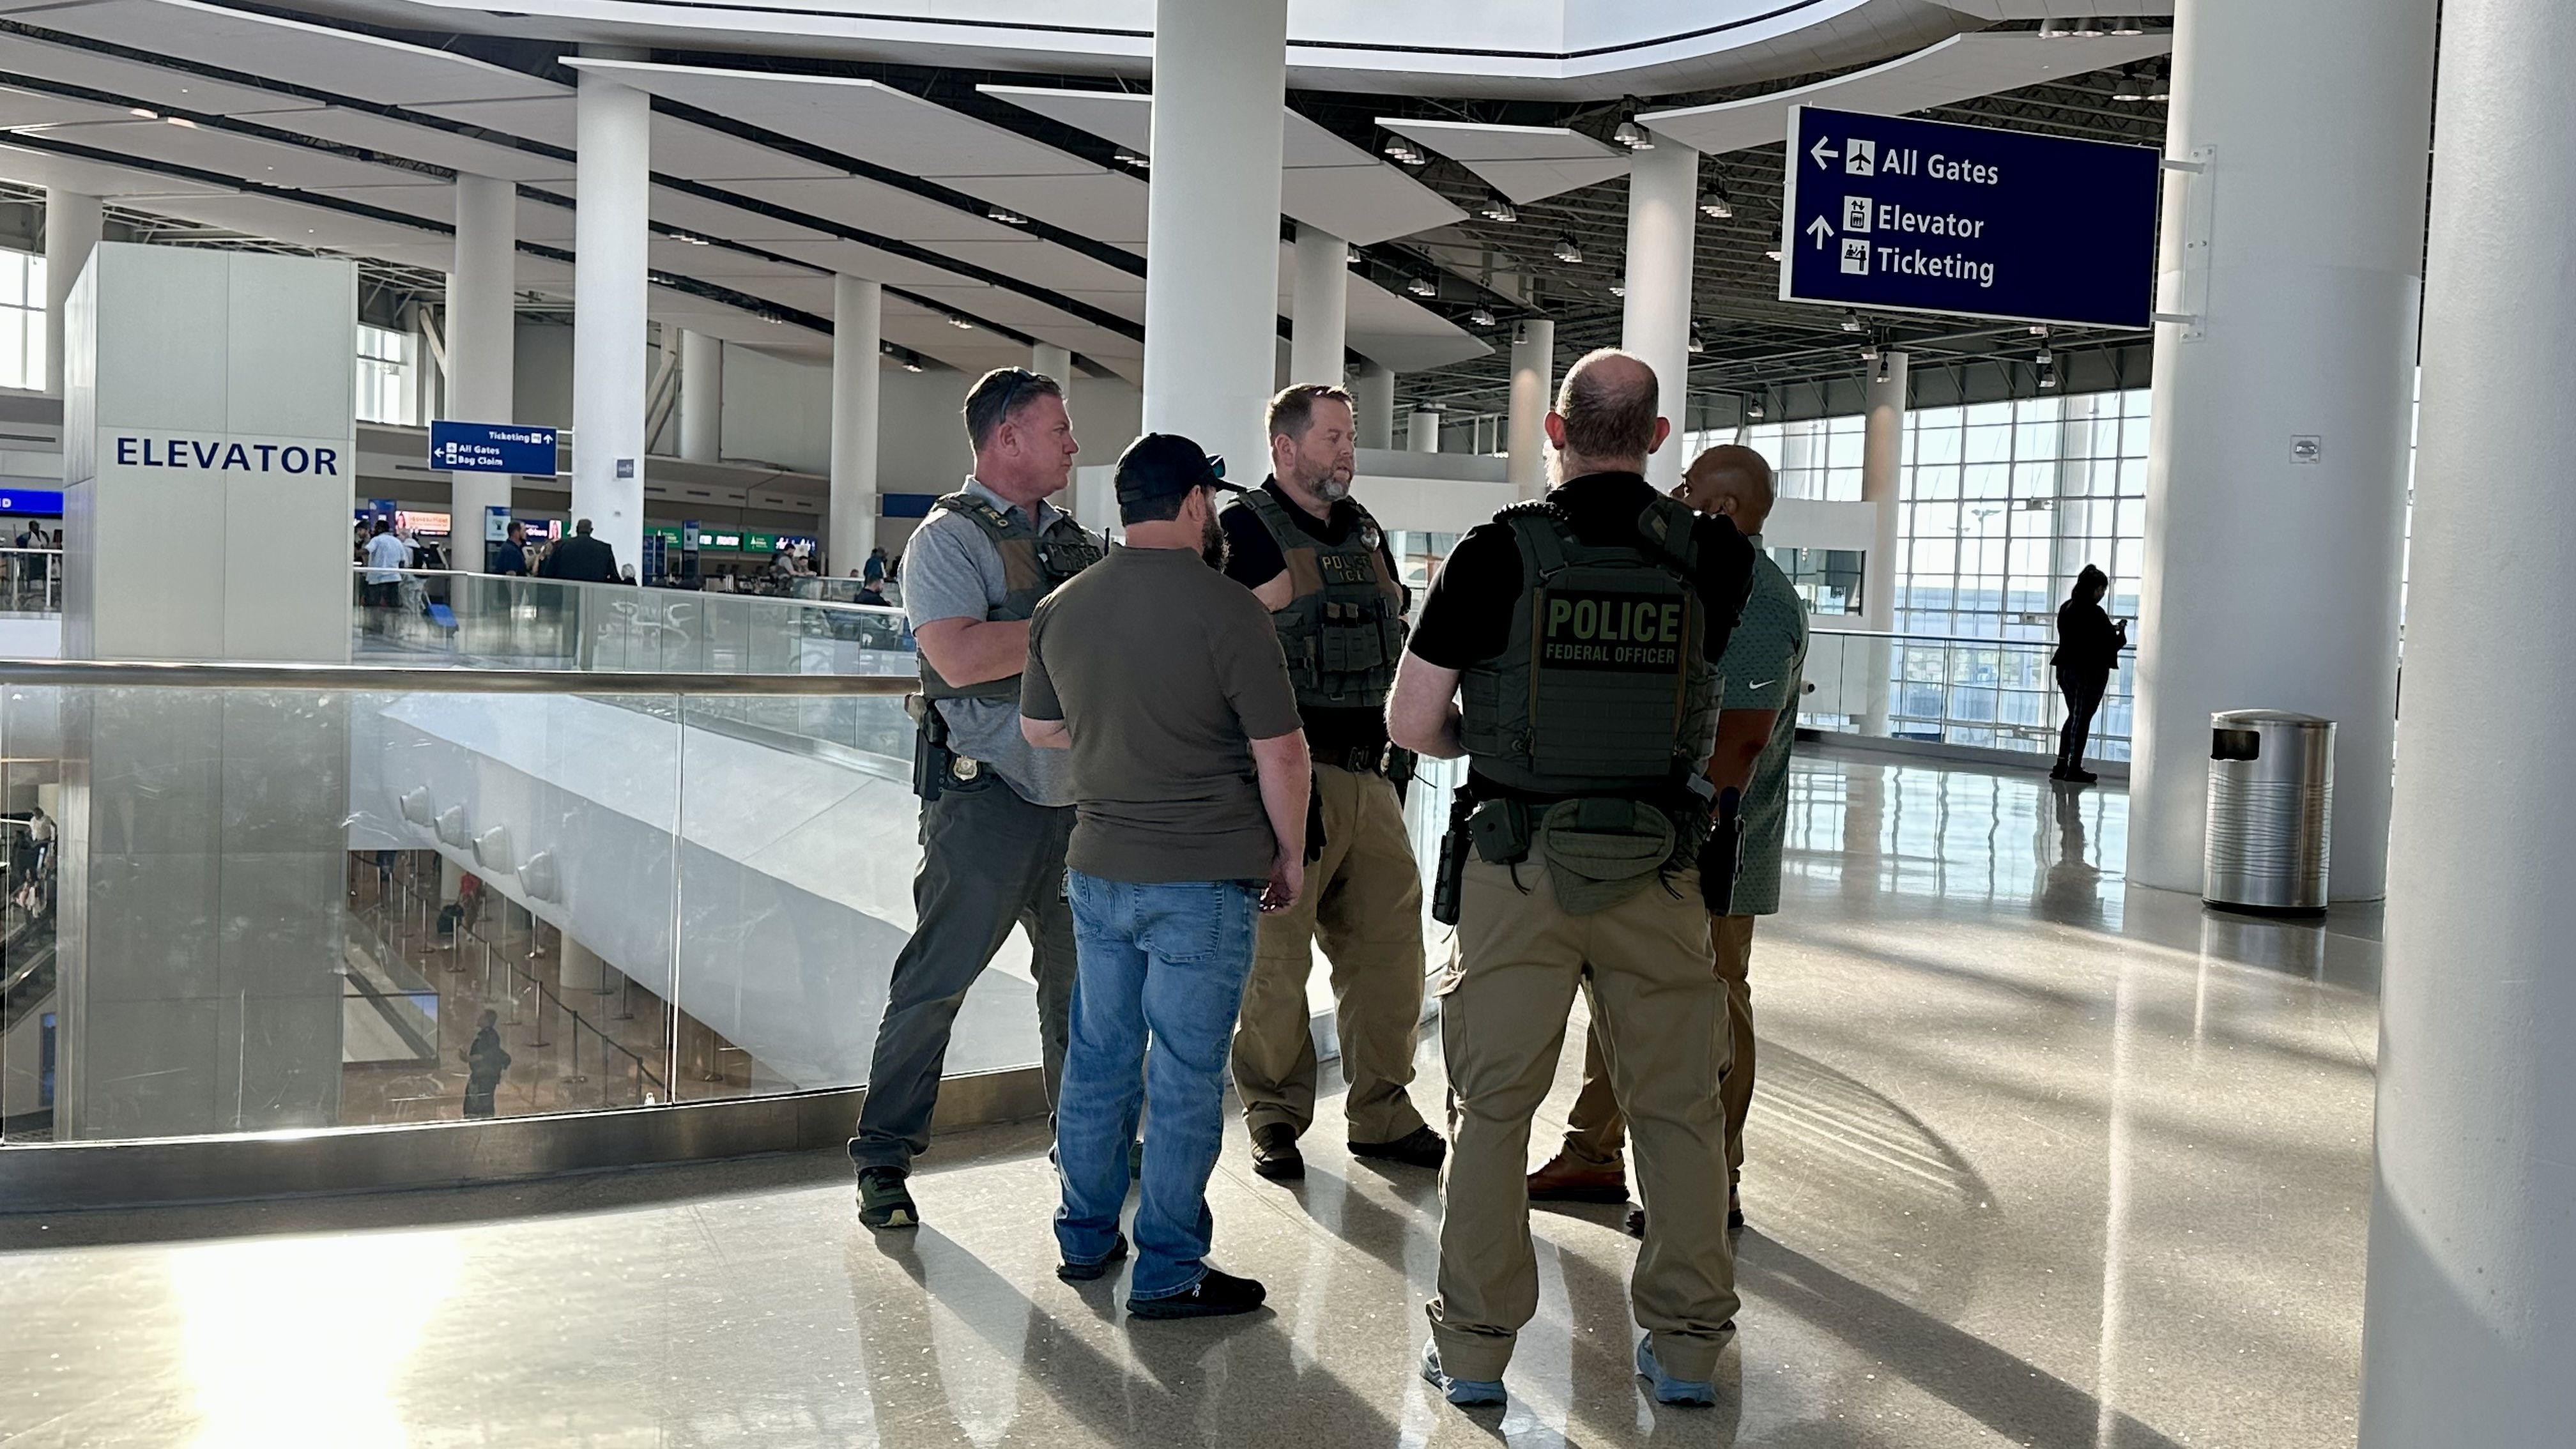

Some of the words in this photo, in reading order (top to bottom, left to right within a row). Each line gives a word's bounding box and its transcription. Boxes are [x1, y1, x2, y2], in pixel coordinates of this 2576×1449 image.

[1882, 149, 1917, 176] All
[1928, 154, 1998, 185] Gates
[1879, 204, 1984, 238] Elevator
[1878, 247, 1994, 287] Ticketing
[459, 445, 471, 453] All
[473, 445, 500, 455] Gates
[489, 431, 530, 443] Ticketing
[118, 437, 337, 475] ELEVATOR
[458, 456, 475, 466] Bag
[477, 457, 503, 466] Claim
[1547, 598, 1680, 642] POLICE
[1545, 643, 1609, 661] FEDERAL
[1614, 646, 1675, 664] OFFICER
